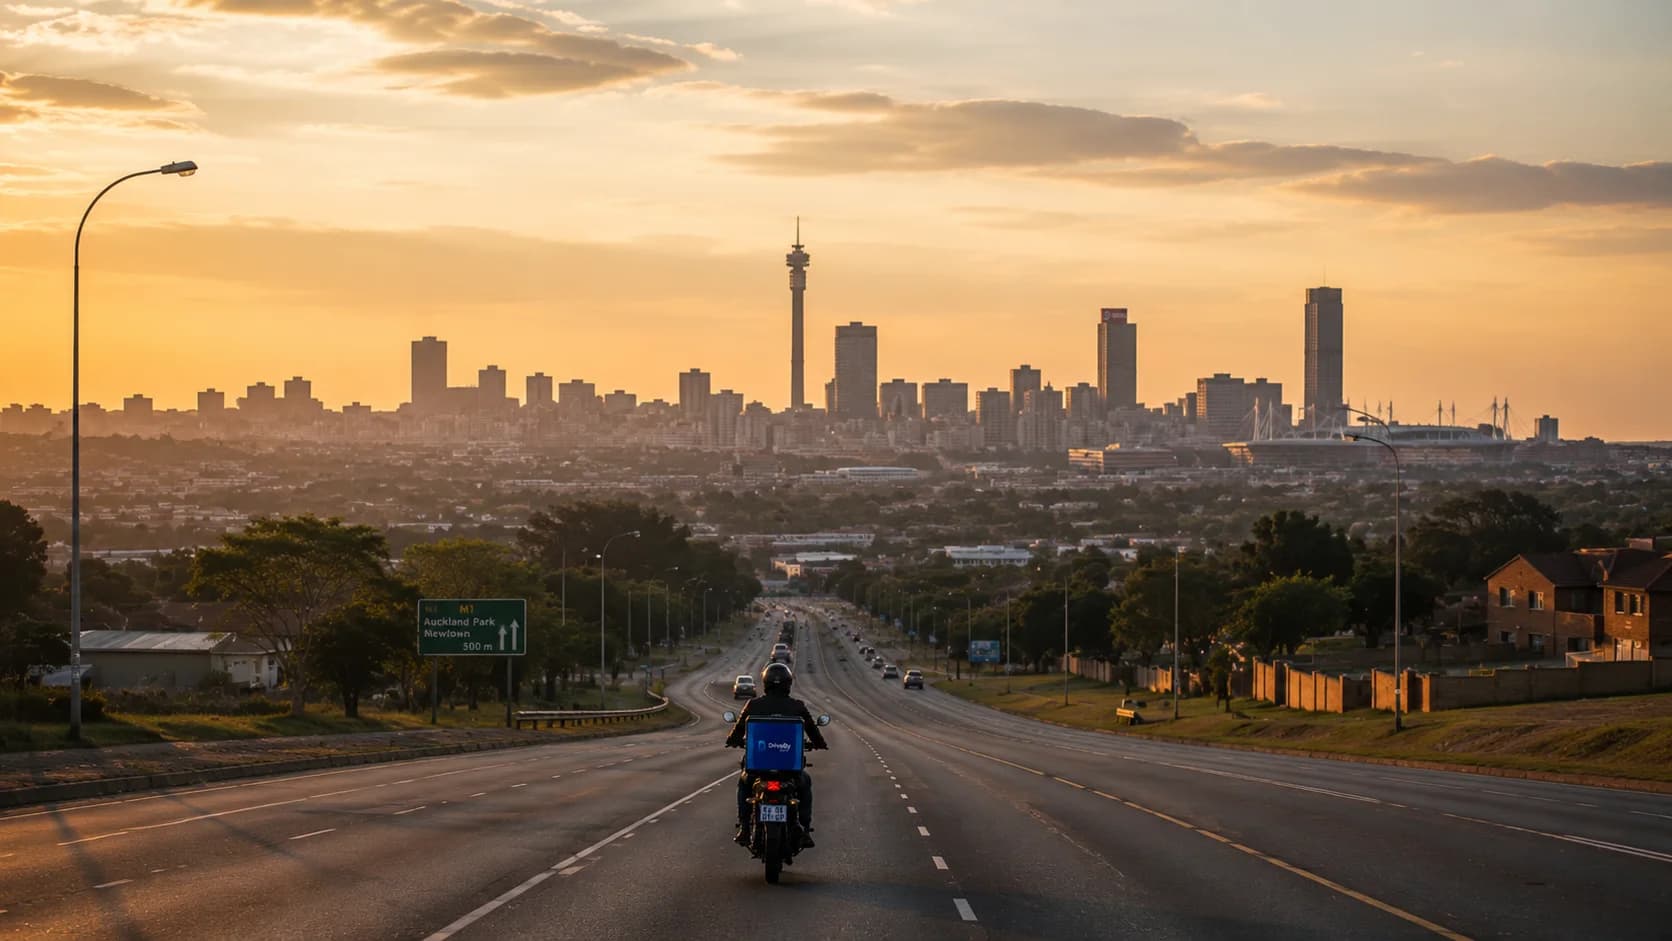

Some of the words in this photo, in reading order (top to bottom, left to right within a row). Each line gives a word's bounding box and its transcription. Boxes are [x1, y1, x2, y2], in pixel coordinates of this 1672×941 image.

[424, 617, 469, 626] Auckland
[473, 617, 496, 626] Park
[463, 642, 481, 651] 500
